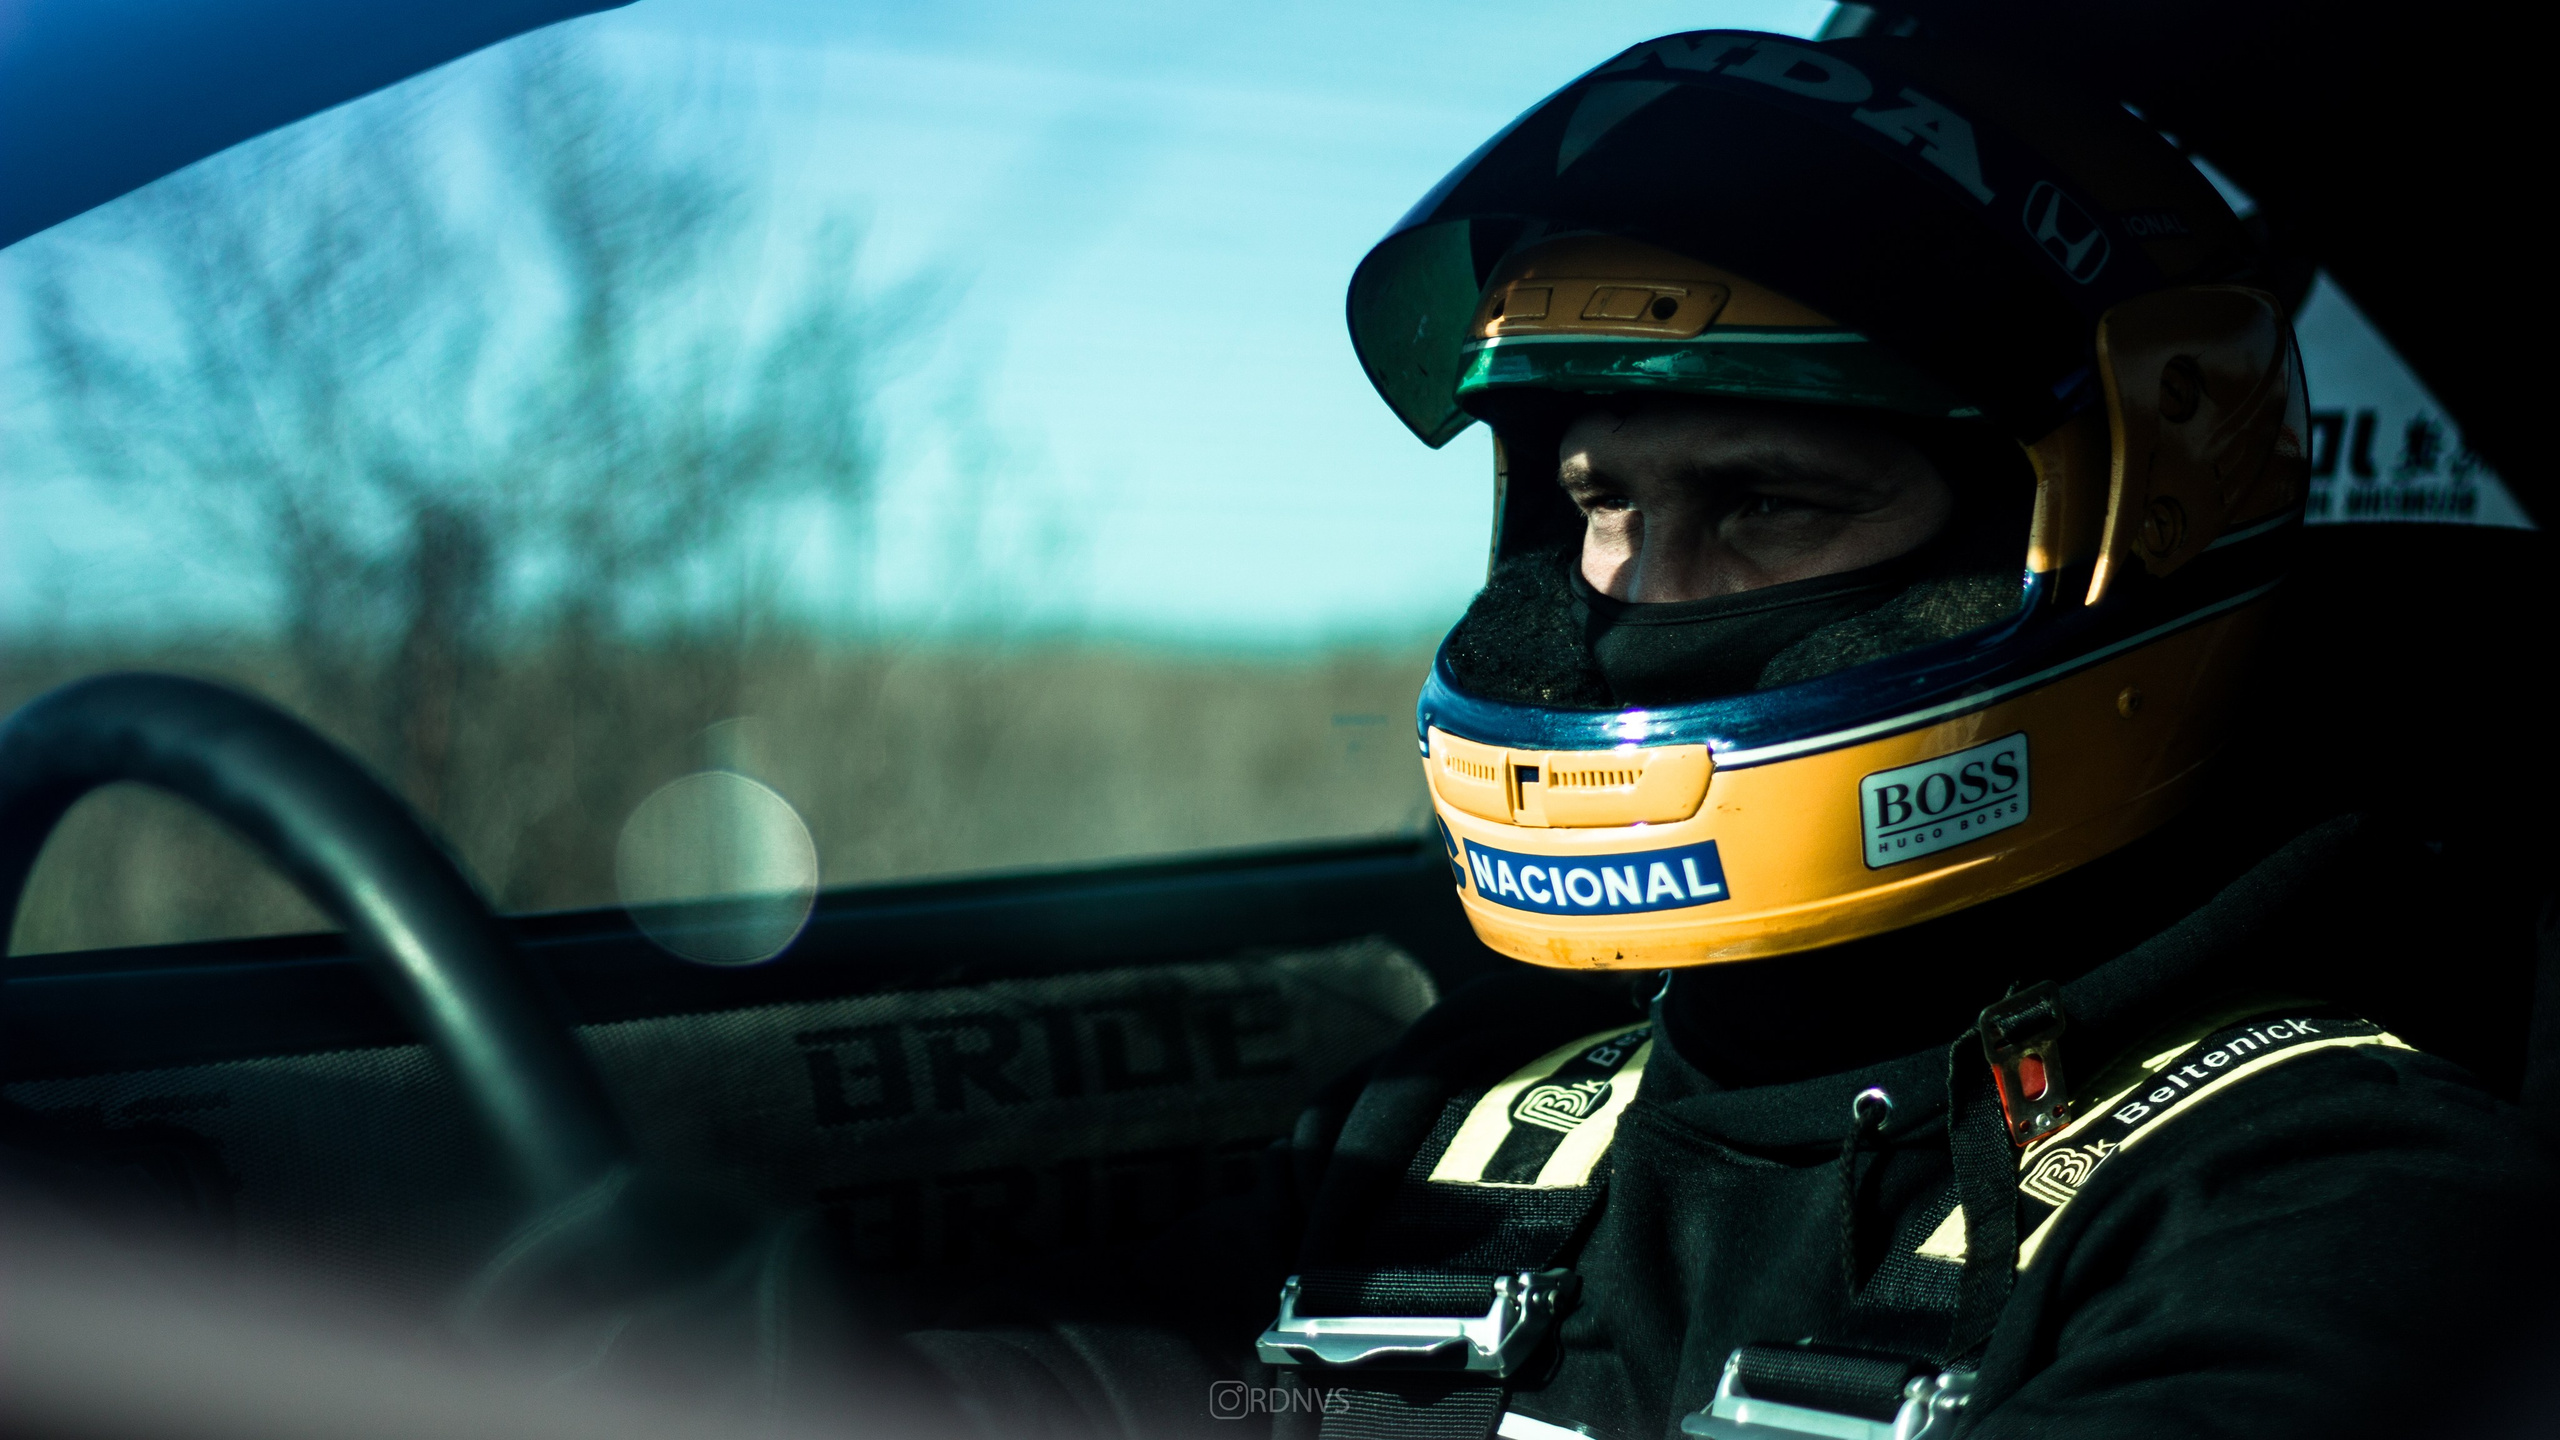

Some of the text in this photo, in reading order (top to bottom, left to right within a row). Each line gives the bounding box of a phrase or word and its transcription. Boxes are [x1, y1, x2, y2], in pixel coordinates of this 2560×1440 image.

[1873, 750, 2019, 830] BOSS
[1878, 802, 2019, 854] HUGO BOSS
[1468, 848, 1721, 907] NACIONAL
[796, 978, 1296, 1128] BRIDE
[2111, 1016, 2321, 1125] Beltenick
